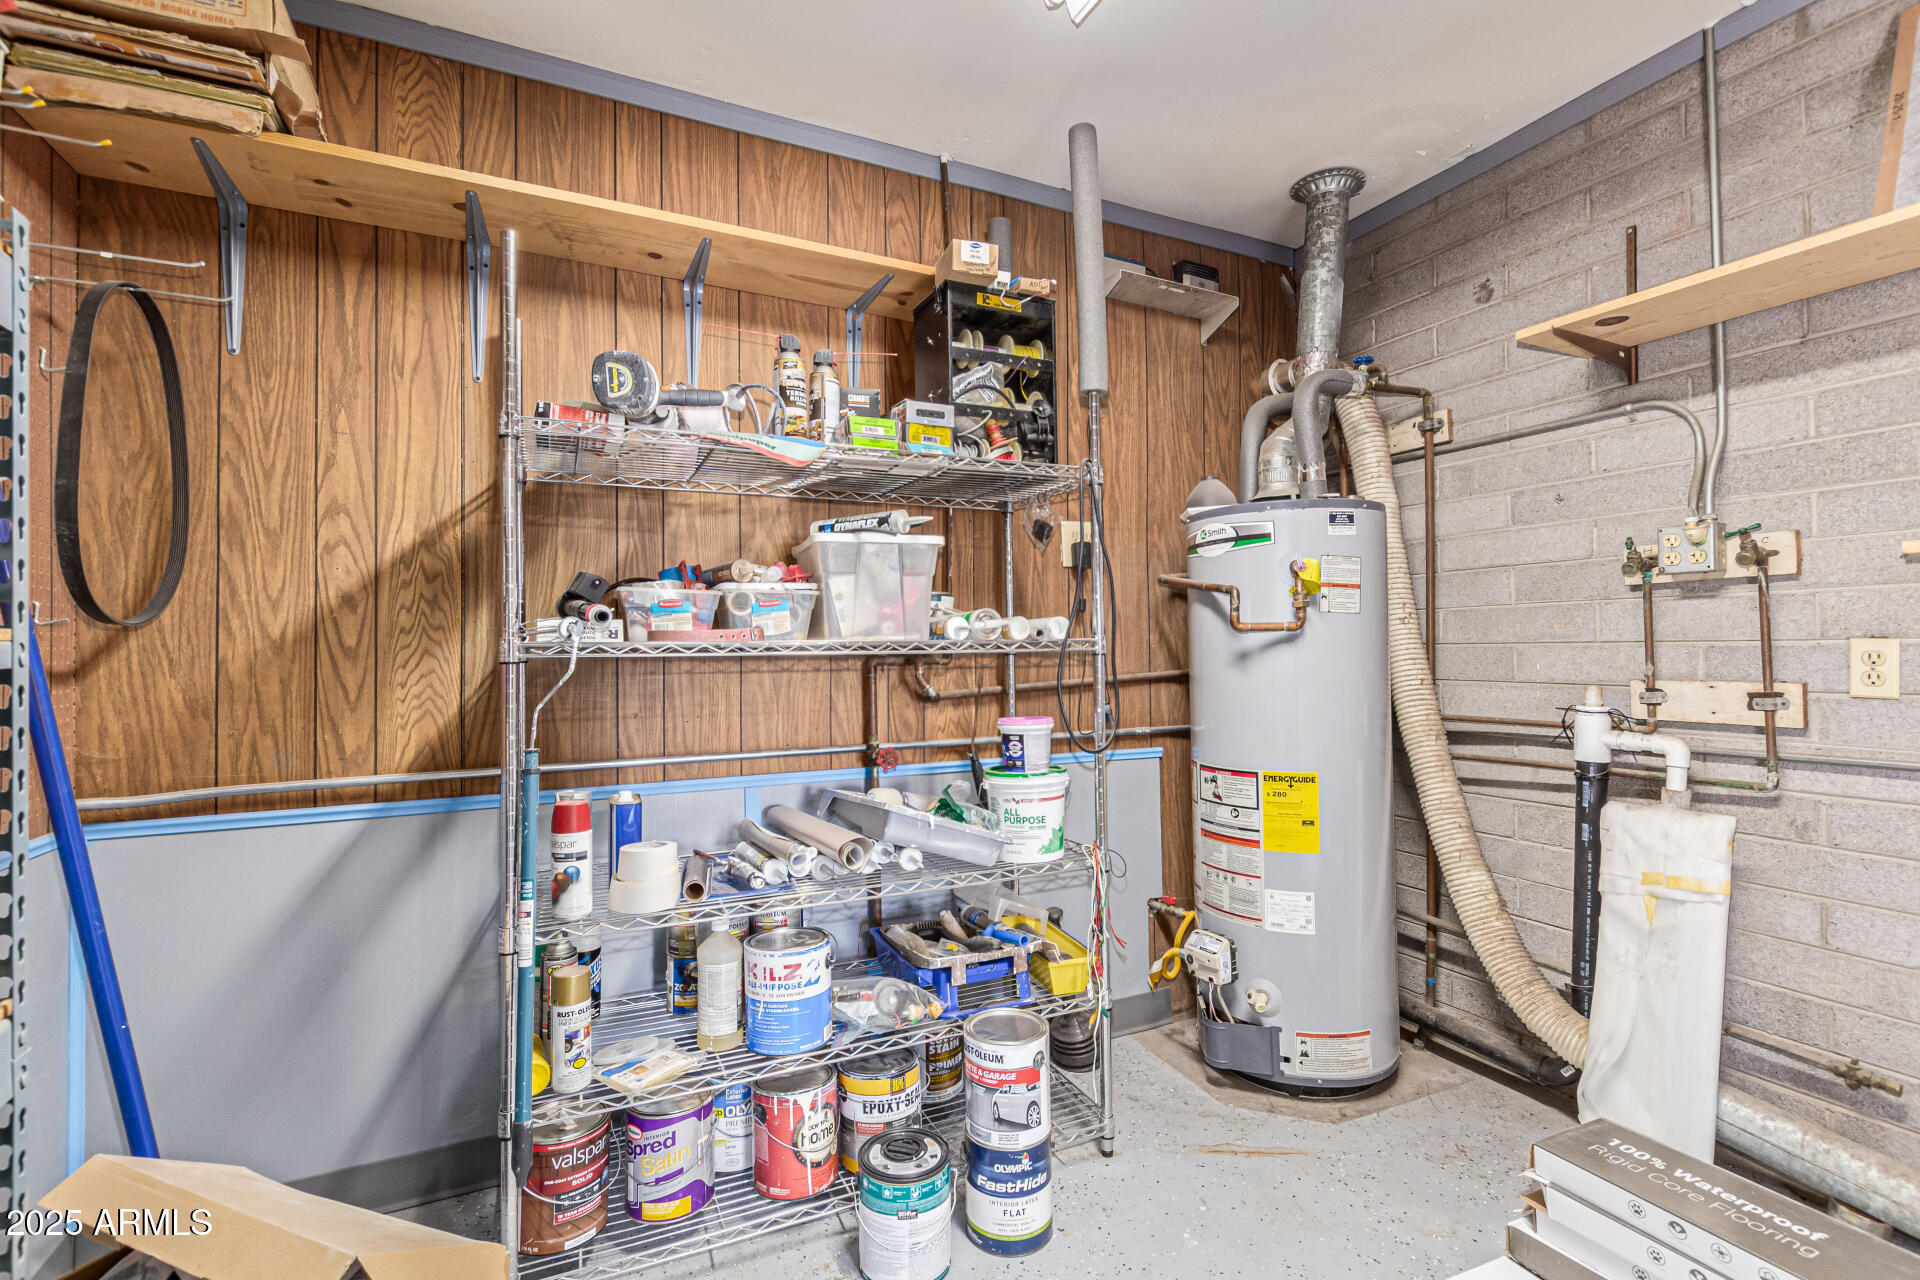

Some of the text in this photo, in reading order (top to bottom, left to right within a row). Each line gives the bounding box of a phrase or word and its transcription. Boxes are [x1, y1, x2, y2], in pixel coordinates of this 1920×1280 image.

[160, 2, 198, 18] MOBILE
[833, 518, 880, 532] DYNAFLEX
[1207, 527, 1227, 537] Smith
[1003, 807, 1021, 817] ALL
[1004, 815, 1047, 825] PURPOSE
[552, 839, 577, 852] alspar
[929, 1036, 960, 1055] STAIN
[983, 1072, 1017, 1081] GARAGE
[627, 1130, 676, 1160] Spred
[552, 1135, 608, 1170] valspar
[641, 1146, 690, 1175] Satin
[994, 1161, 1033, 1174] OLYMPIC
[572, 1172, 594, 1187] SOLID
[977, 1171, 1048, 1193] FastHide
[1608, 1138, 1830, 1241] 100% Waterproof
[989, 1199, 1019, 1207] INTERIOR
[1588, 1144, 1822, 1259] Rigid Core Flooring
[1003, 1208, 1027, 1217] FLAT
